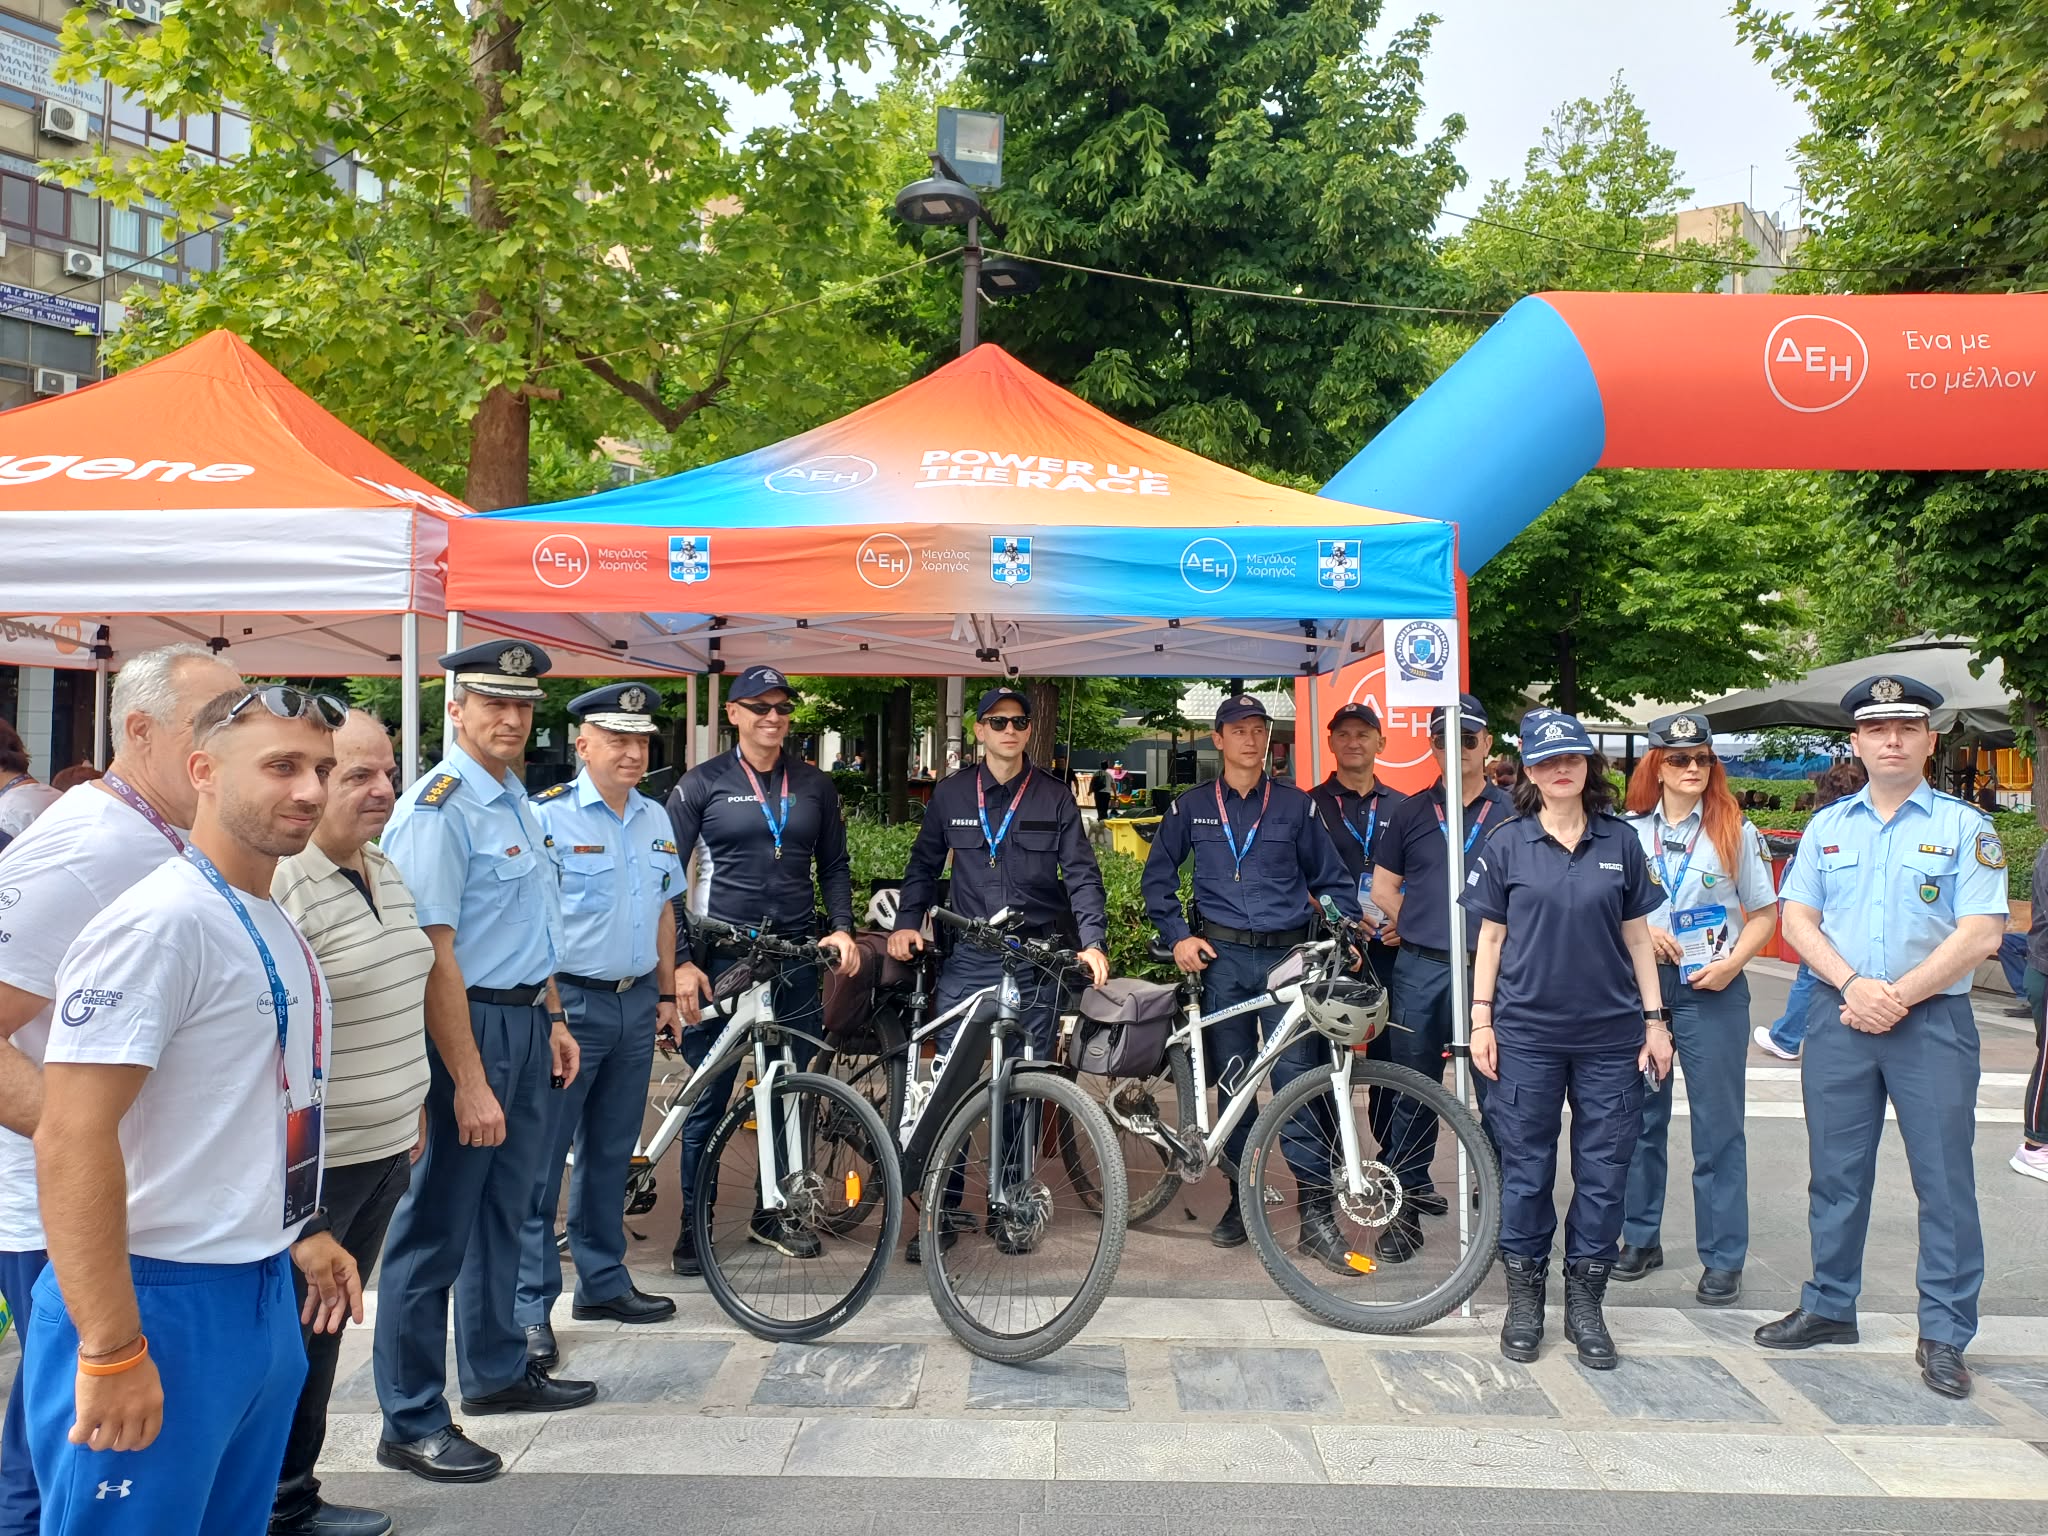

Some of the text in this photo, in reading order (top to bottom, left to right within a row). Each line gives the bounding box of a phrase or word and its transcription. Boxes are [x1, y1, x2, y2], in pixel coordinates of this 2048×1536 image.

[1902, 330, 1991, 355] Ένα με
[1776, 337, 1851, 382] ΔΕΗ
[1906, 366, 2037, 394] το μέλλον
[0, 455, 256, 486] gene
[921, 449, 1096, 476] POWER
[778, 468, 859, 483] ΔΕΗ
[919, 465, 1171, 496] THE RACE
[539, 547, 582, 573] ΔΕΗ
[598, 548, 648, 560] Μεγάλος
[862, 548, 904, 573] ΔΕΗ
[921, 549, 971, 561] Μεγάλος
[1246, 554, 1297, 566] Μεγάλος
[598, 560, 648, 572] Χορηγός
[921, 561, 969, 573] Χορηγός
[1186, 552, 1229, 578] ΔΕΗ
[1246, 565, 1296, 578] Χορηγός
[1396, 622, 1449, 667] ΕΛΛΗΝΙΚΗ ΑΣΤΥΝΟΜΙΑ
[727, 795, 759, 803] POLICE
[82, 997, 118, 1007] GREECE
[84, 989, 124, 1000] CYCLING
